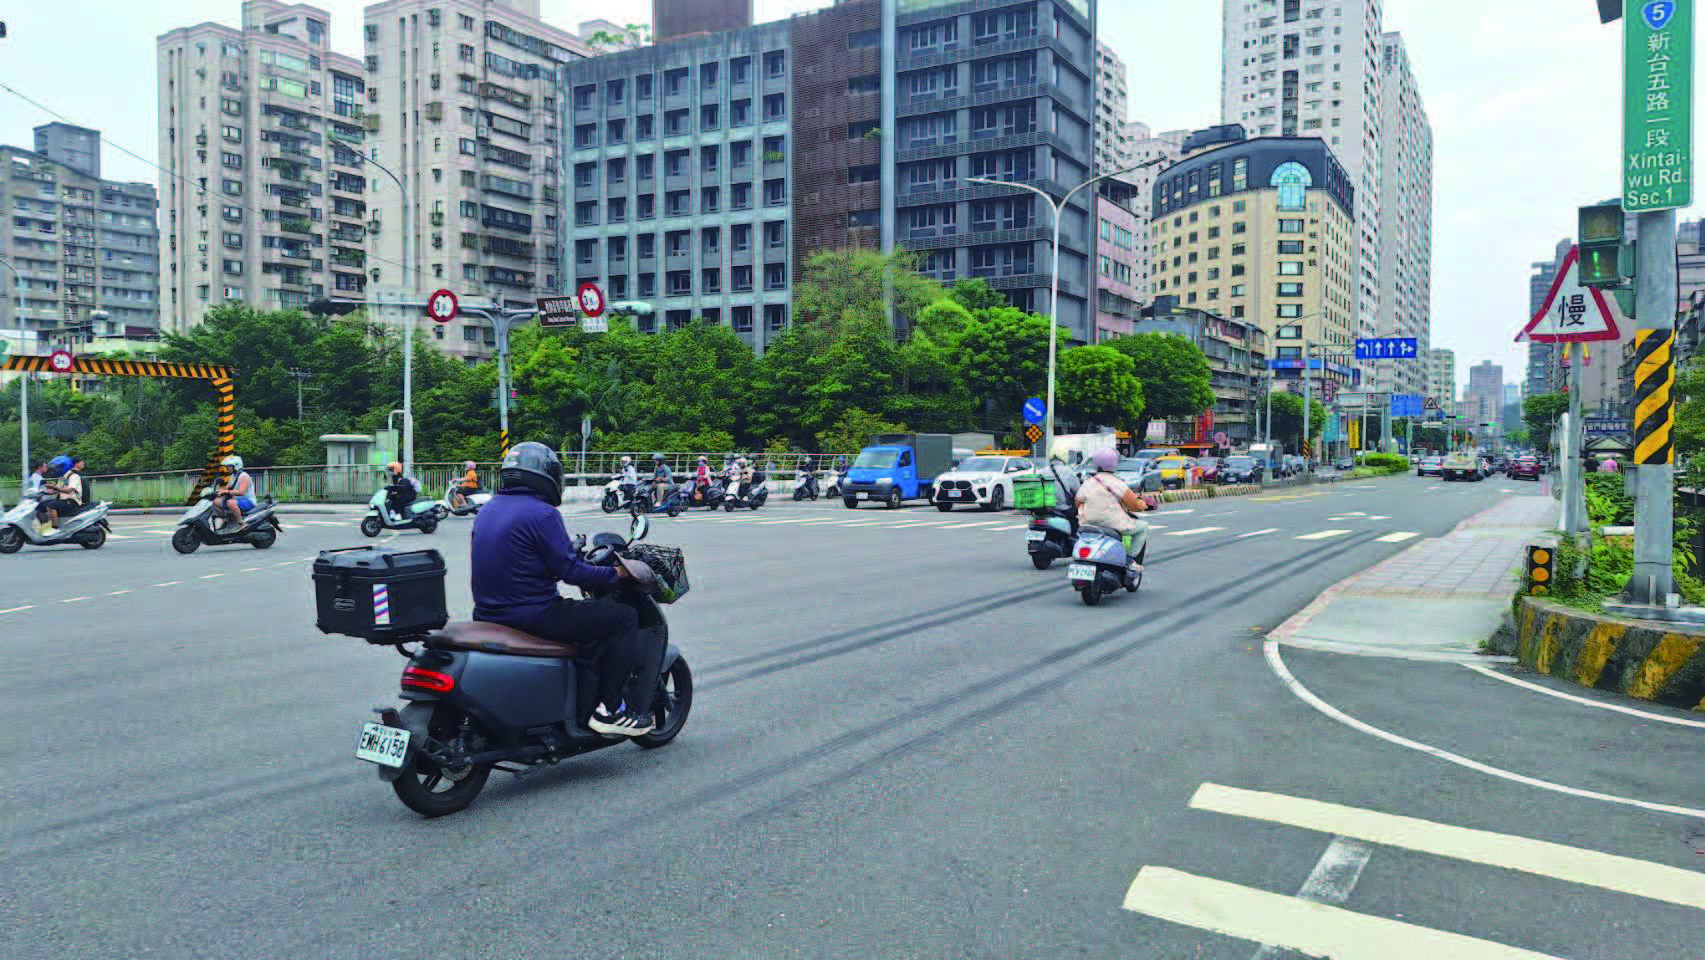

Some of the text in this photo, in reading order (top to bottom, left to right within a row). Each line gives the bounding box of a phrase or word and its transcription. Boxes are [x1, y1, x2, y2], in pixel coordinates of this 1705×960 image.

[1652, 4, 1666, 21] 5
[1646, 32, 1671, 148] 新台五路一段
[1628, 149, 1687, 170] Xintai-
[1627, 168, 1686, 188] wu Rd.
[1627, 187, 1673, 207] Sec.1
[1558, 294, 1586, 328] 慢
